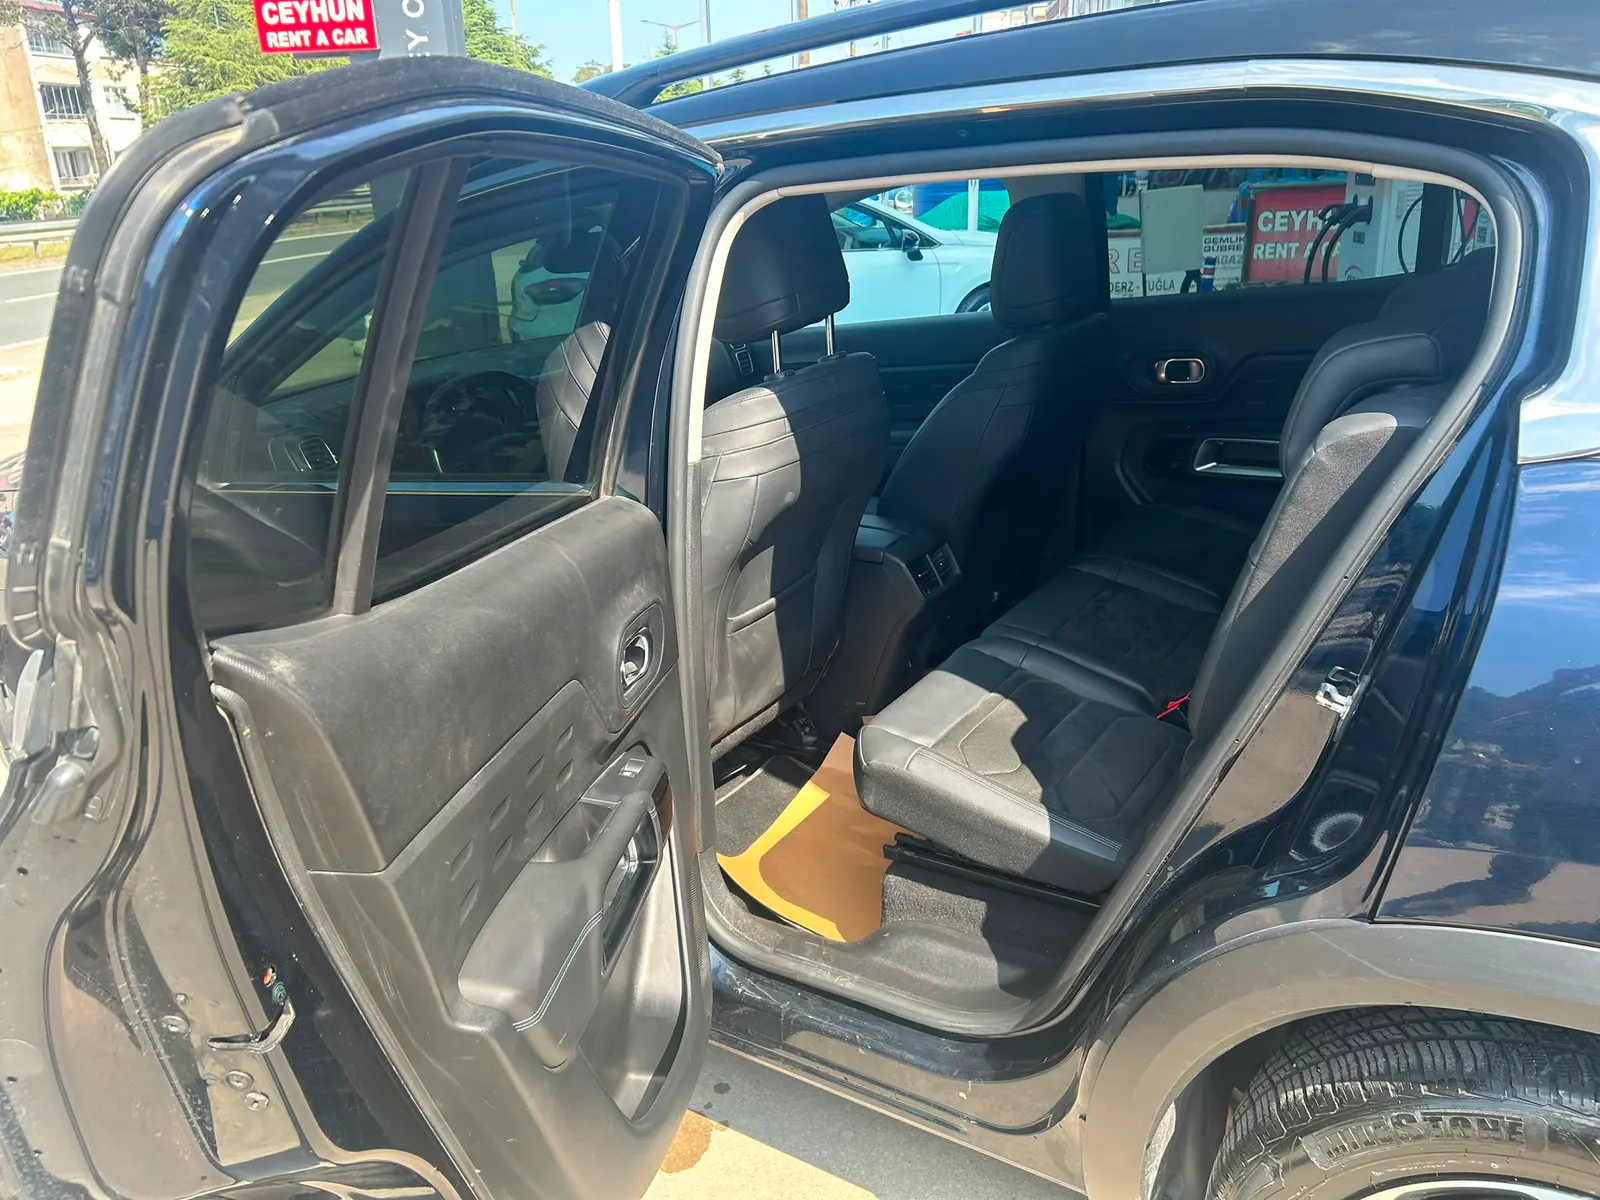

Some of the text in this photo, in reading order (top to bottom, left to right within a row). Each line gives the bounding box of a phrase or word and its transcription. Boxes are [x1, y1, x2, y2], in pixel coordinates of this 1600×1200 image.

[261, 0, 365, 25] CEYHUN
[266, 27, 369, 48] RENT A CAR
[1252, 242, 1300, 260] RENT
[1146, 277, 1175, 291] UĞLA
